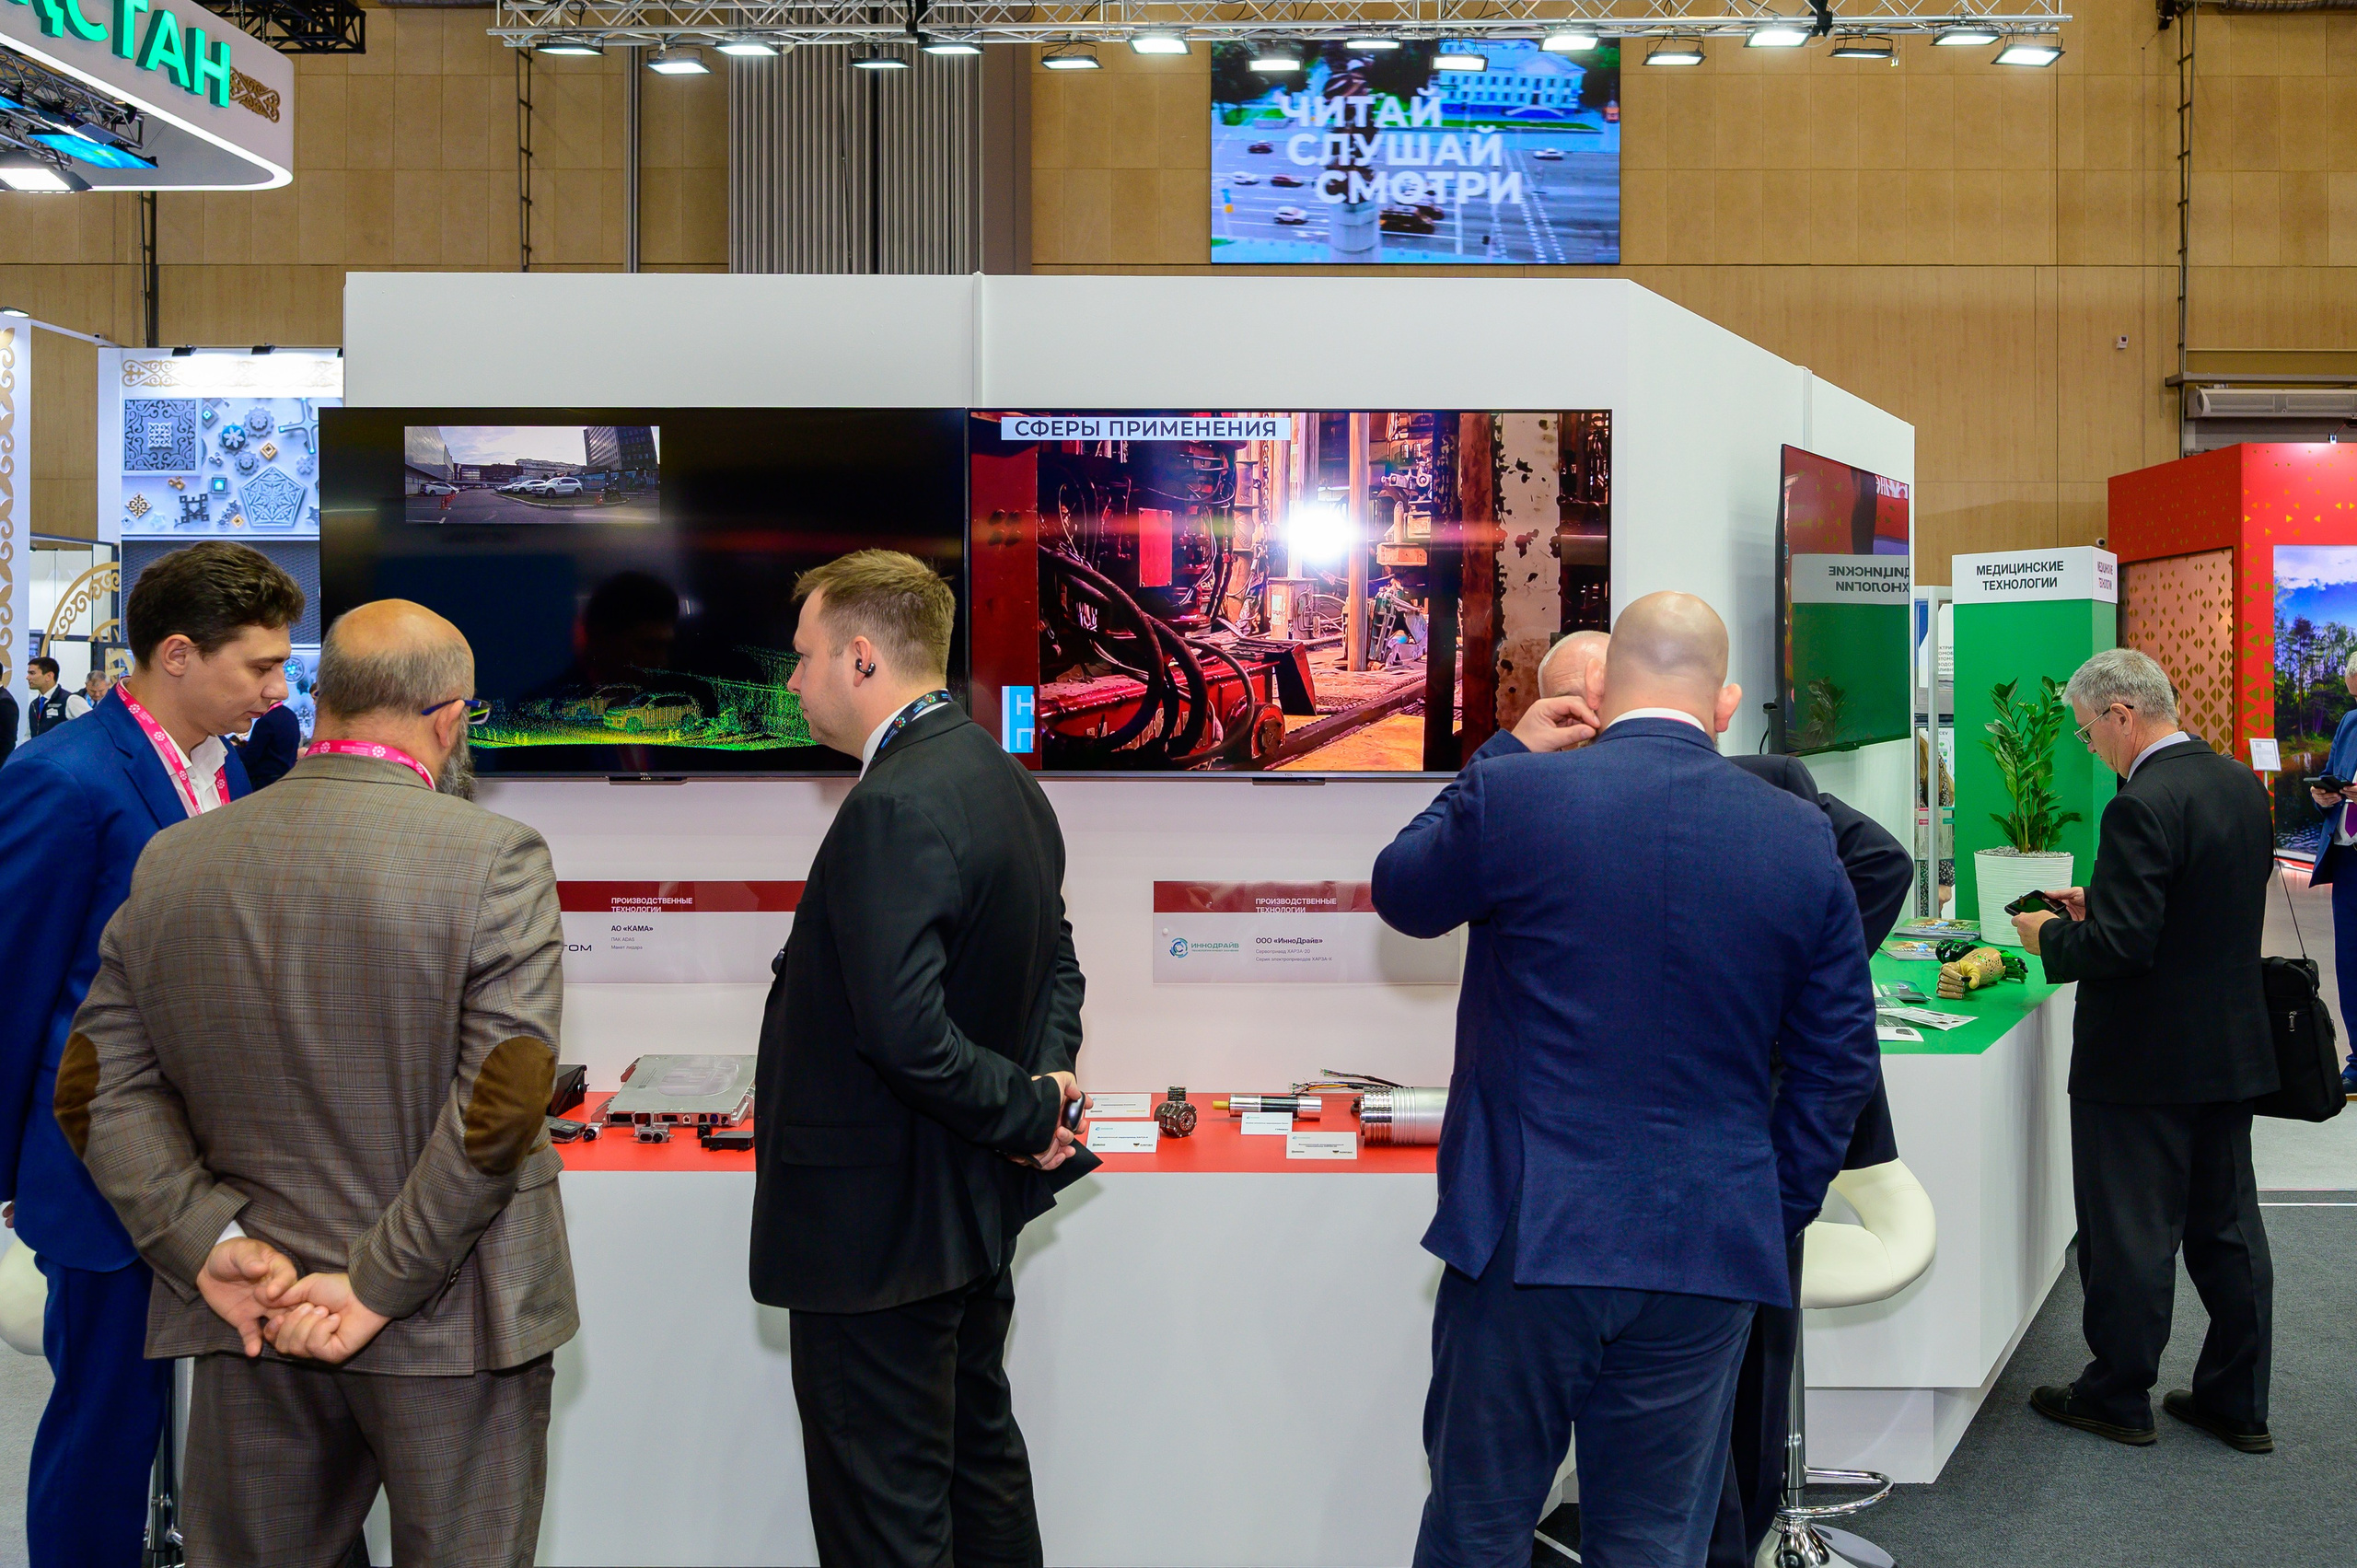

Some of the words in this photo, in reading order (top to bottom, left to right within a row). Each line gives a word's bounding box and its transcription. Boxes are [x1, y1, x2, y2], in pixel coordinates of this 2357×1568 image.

[1280, 87, 1443, 128] ЧИТАЙ
[1286, 124, 1504, 167] СЛУШАЙ
[1315, 170, 1523, 204] СМОТРИ
[1014, 419, 1100, 437] СФЕРЫ
[1109, 420, 1277, 437] ПРИМЕНЕНИЯ
[1976, 560, 2064, 576] МЕДИЦИНСКИЕ
[1982, 576, 2058, 591] ТЕХНОЛОГИИ
[610, 897, 693, 905] ПРОИЗВОДСТВЕННЫЕ
